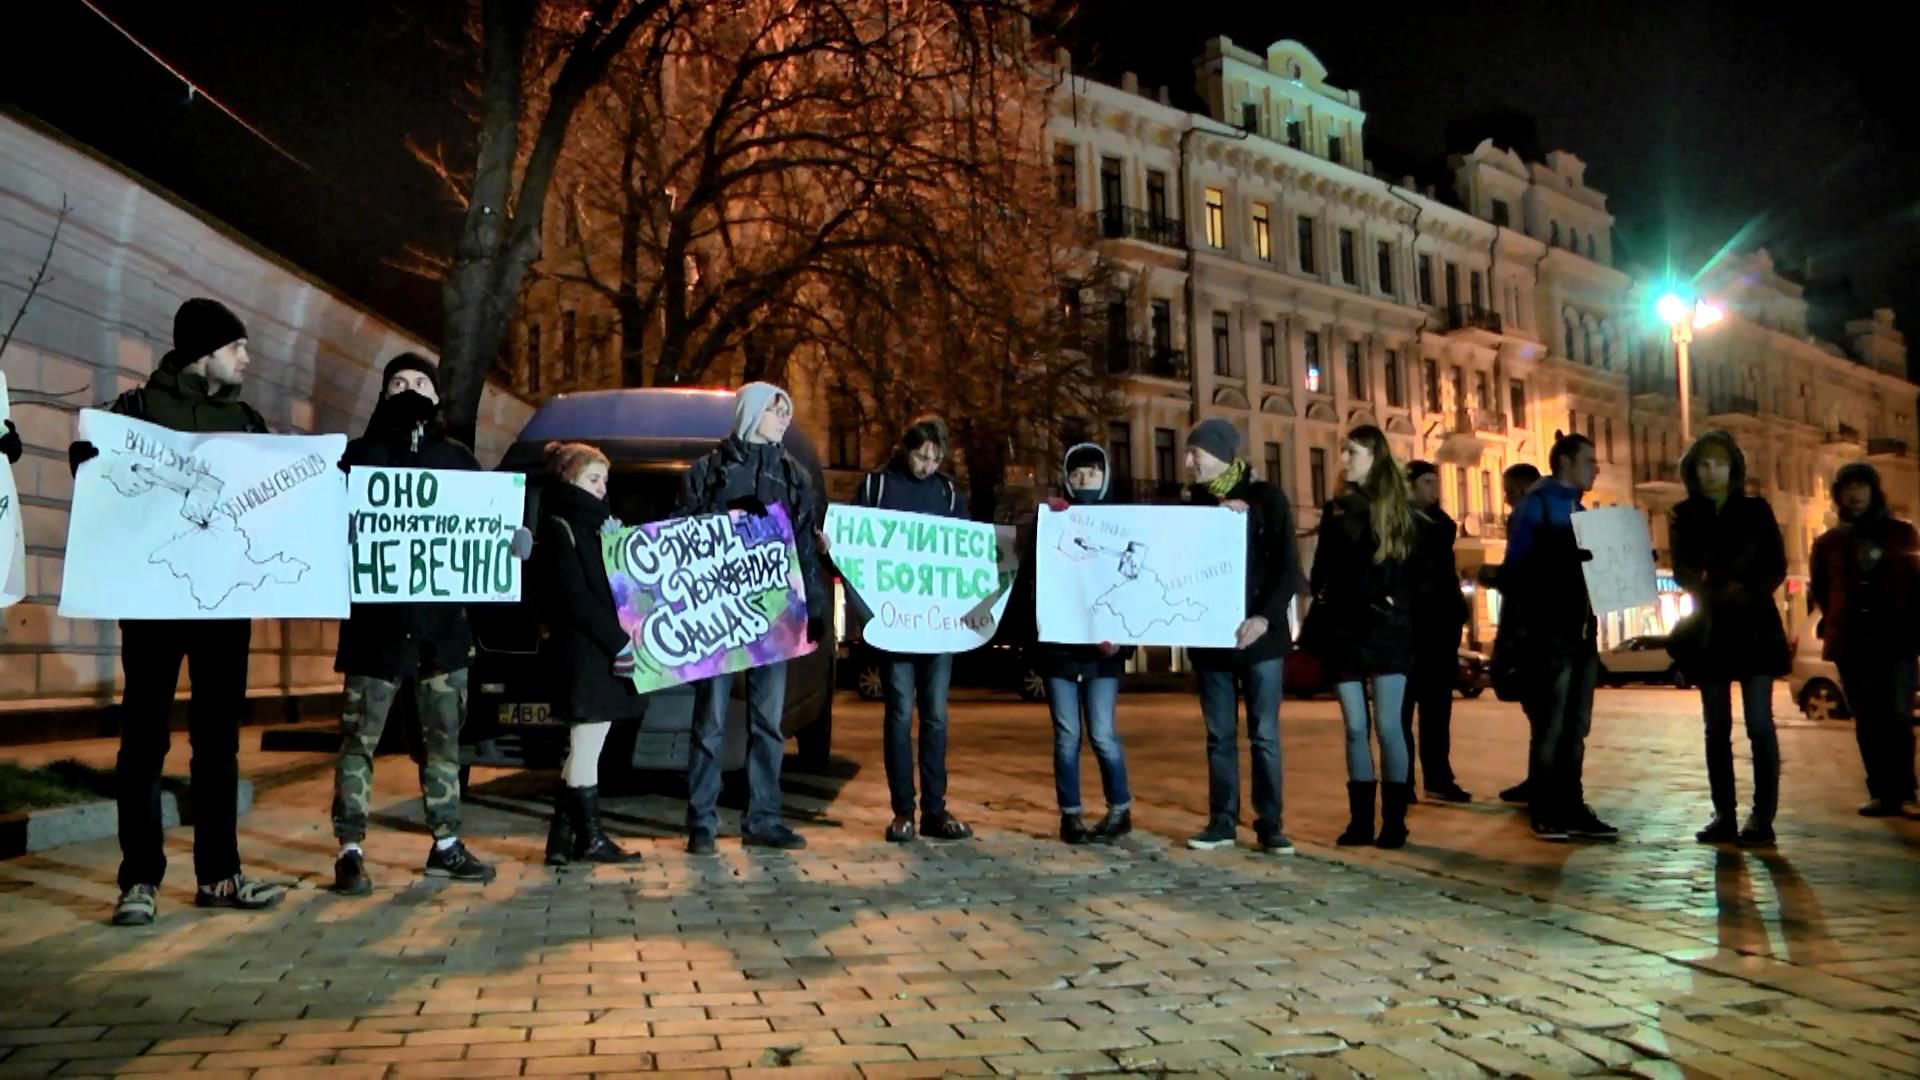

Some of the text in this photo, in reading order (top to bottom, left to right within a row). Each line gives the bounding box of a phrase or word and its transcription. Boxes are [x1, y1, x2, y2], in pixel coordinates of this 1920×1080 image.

[367, 471, 438, 508] ОНО
[352, 538, 514, 596] НЕ ВЕЧНО
[629, 532, 660, 574] С
